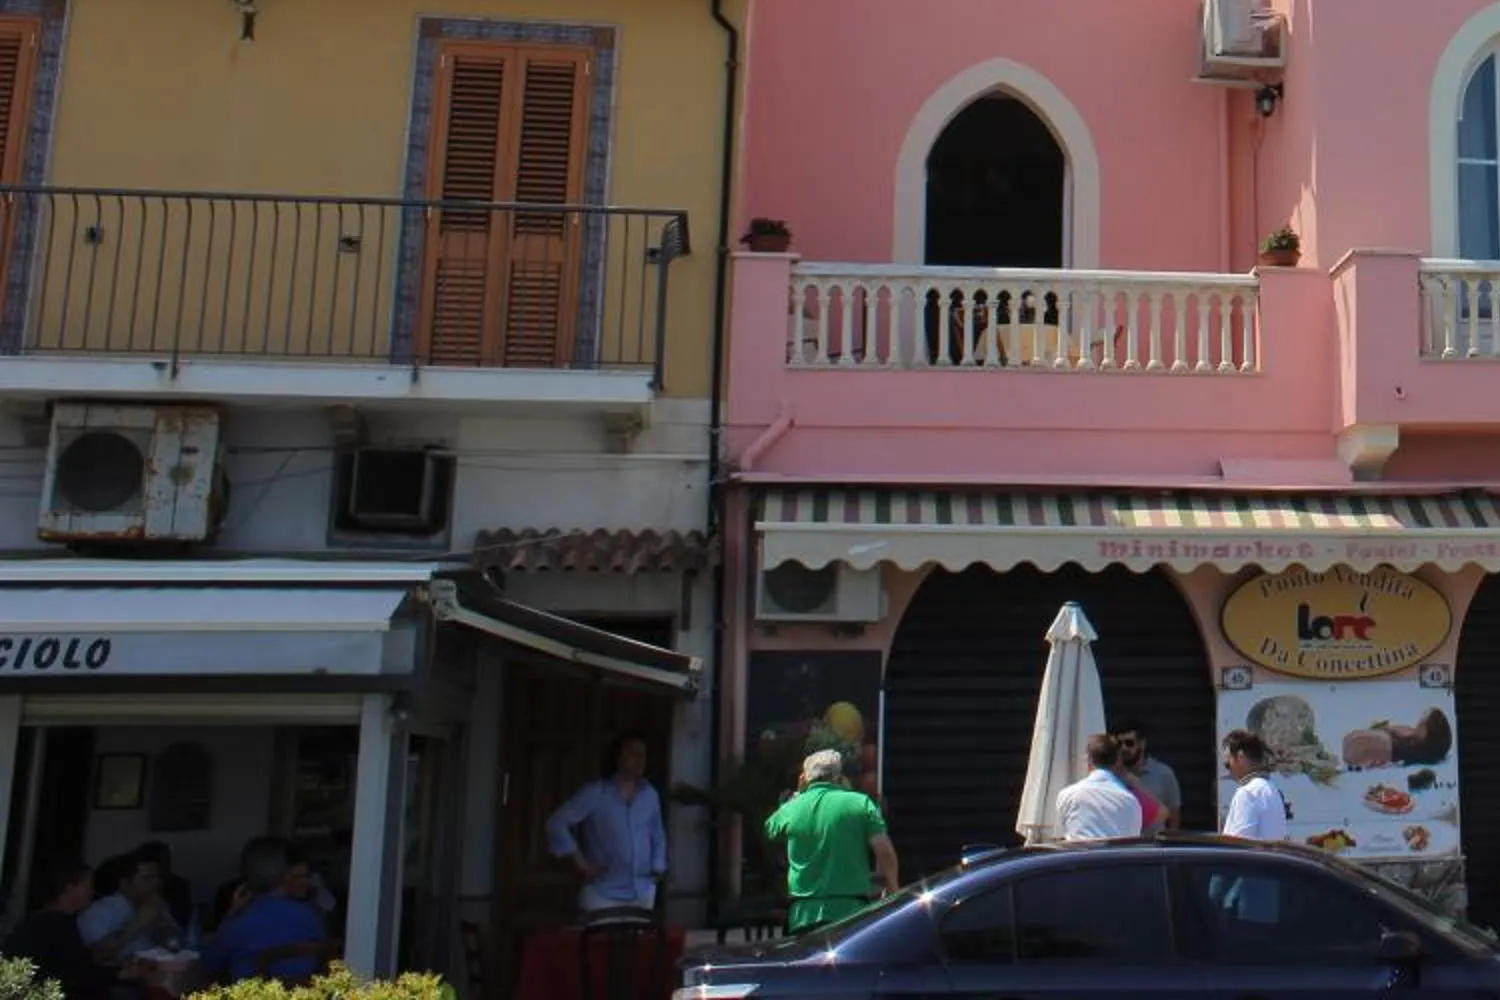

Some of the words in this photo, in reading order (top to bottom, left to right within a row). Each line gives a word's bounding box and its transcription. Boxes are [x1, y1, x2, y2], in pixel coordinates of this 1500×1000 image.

[1097, 538, 1315, 559] Minimarket
[1260, 635, 1289, 665] Da
[1296, 642, 1418, 674] Concettina
